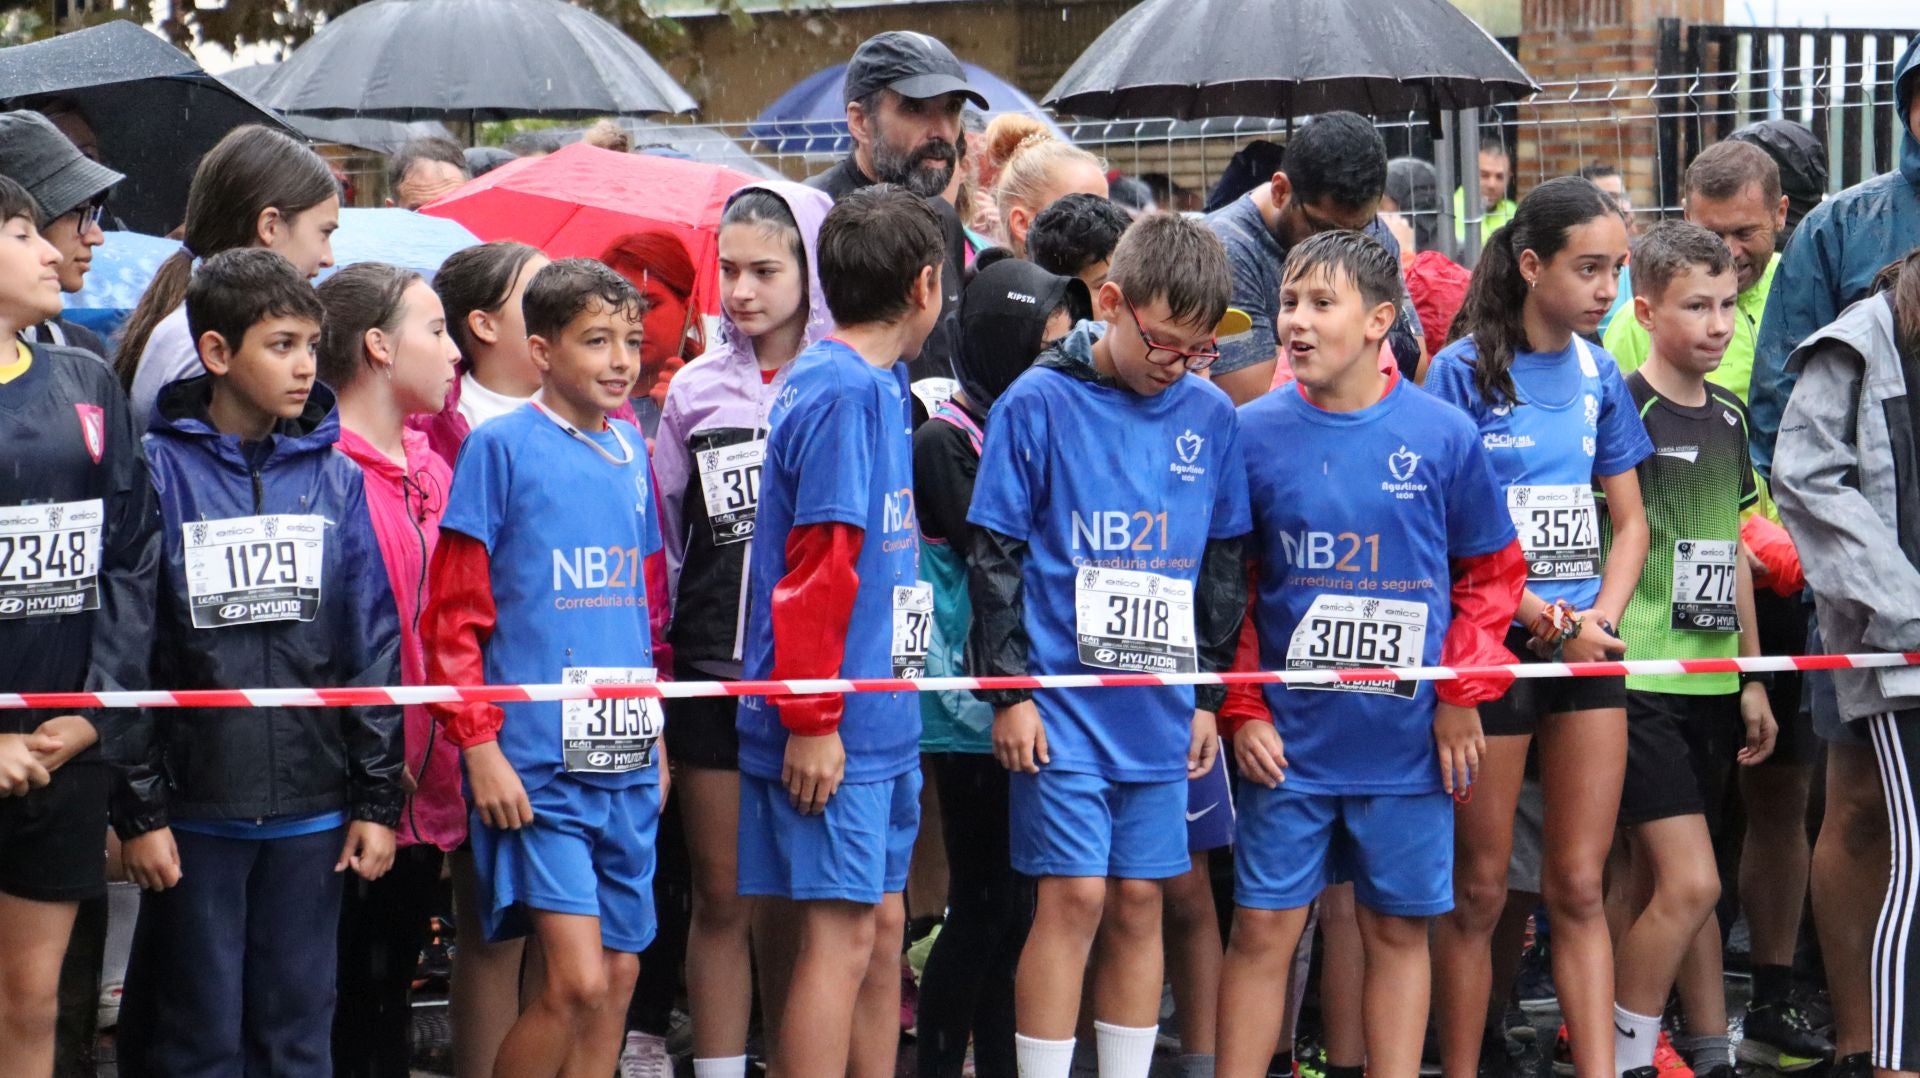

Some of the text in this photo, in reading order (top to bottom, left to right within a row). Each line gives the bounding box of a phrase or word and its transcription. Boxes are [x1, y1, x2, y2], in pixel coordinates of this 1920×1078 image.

[1007, 291, 1036, 304] KIPSTA
[726, 450, 759, 462] emico
[1170, 463, 1205, 475] Agustinas
[1381, 482, 1427, 493] Agustinas
[70, 511, 98, 520] emico
[216, 527, 255, 537] emico
[1071, 510, 1168, 551] NB21
[1531, 509, 1592, 548] 3523
[0, 531, 85, 581] 2348
[1279, 530, 1380, 572] NB21
[1701, 549, 1724, 557] emico
[225, 542, 297, 588] 1129
[552, 545, 638, 591] NB21
[1150, 557, 1166, 569] de
[1105, 578, 1140, 588] emico
[1358, 578, 1377, 590] de
[1381, 578, 1433, 592] seguros
[1320, 602, 1354, 612] emico
[1385, 608, 1420, 618] emico
[1106, 595, 1169, 641] 3118
[1309, 619, 1402, 663] 3063
[595, 676, 625, 684] emico
[587, 697, 653, 736] 3058
